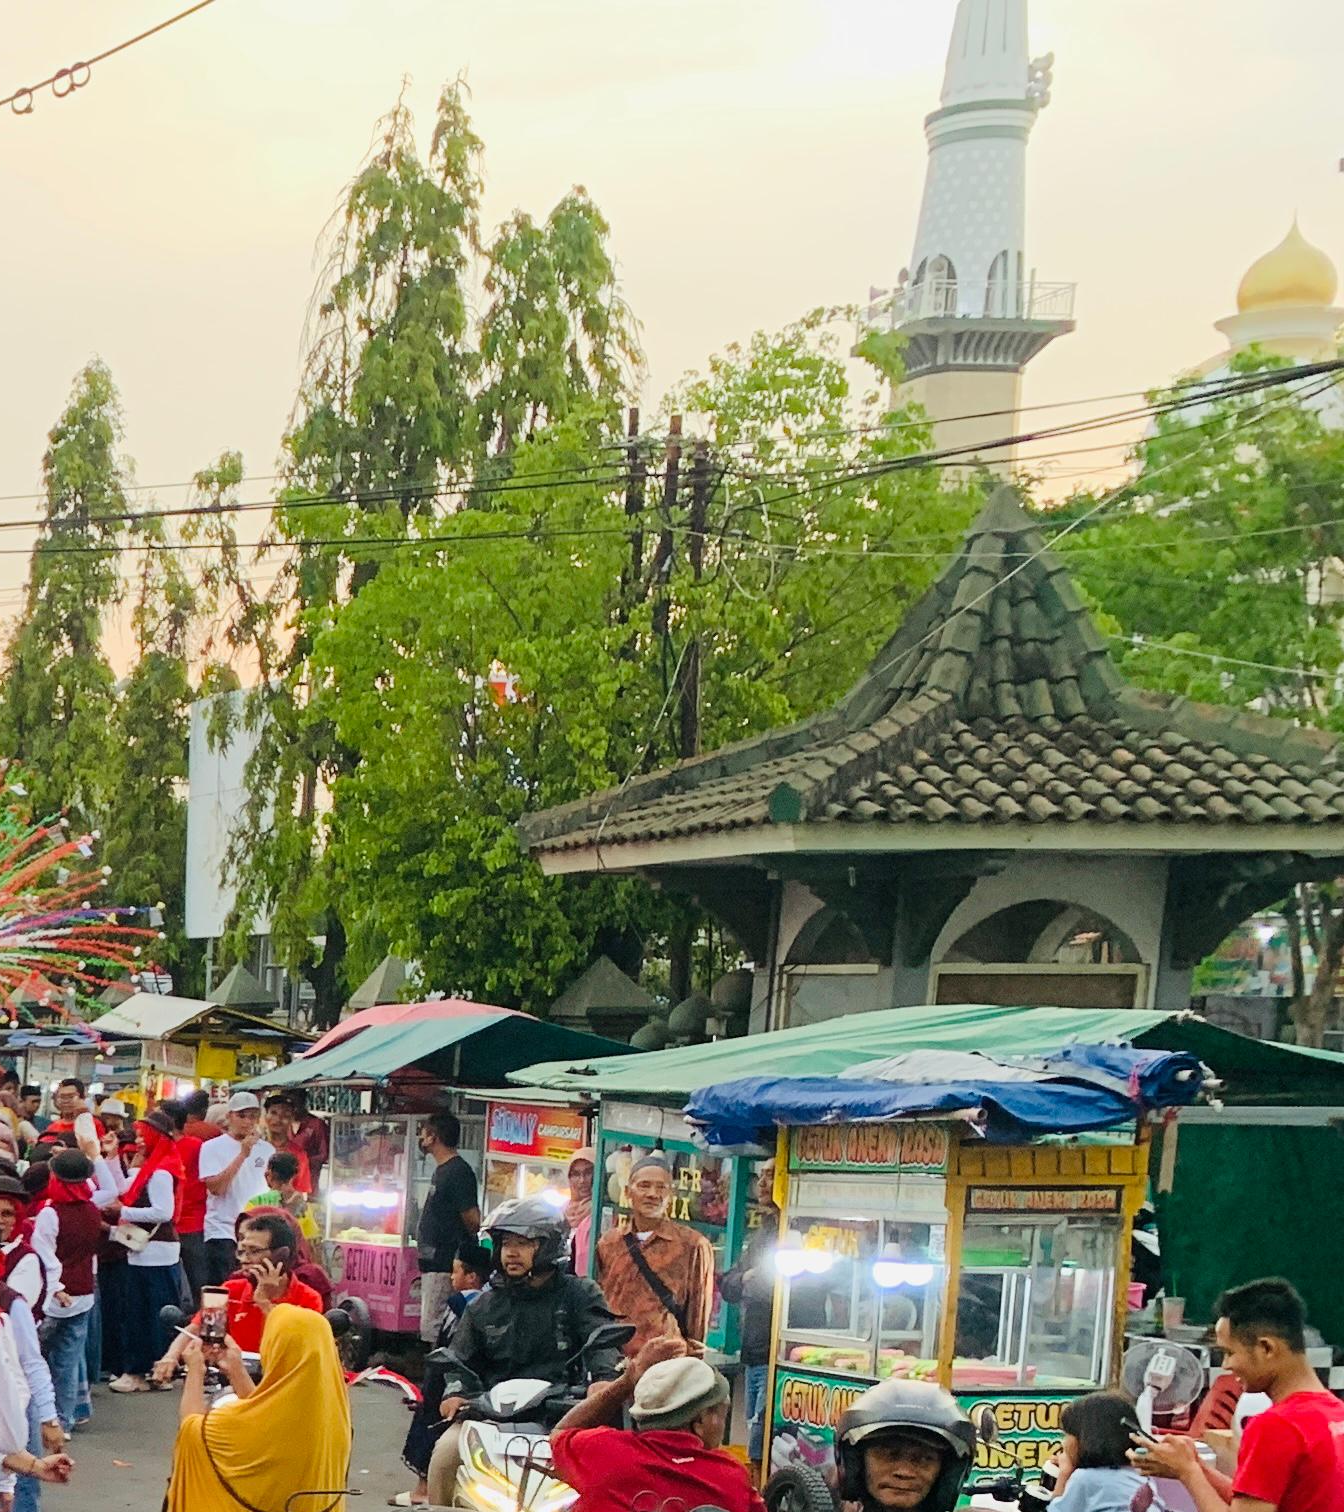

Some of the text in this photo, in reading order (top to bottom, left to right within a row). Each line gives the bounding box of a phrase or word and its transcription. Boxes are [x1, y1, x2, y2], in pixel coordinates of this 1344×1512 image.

[796, 1124, 844, 1164] GETUK
[346, 1247, 377, 1284] GETUK
[782, 1377, 827, 1426] GETUK
